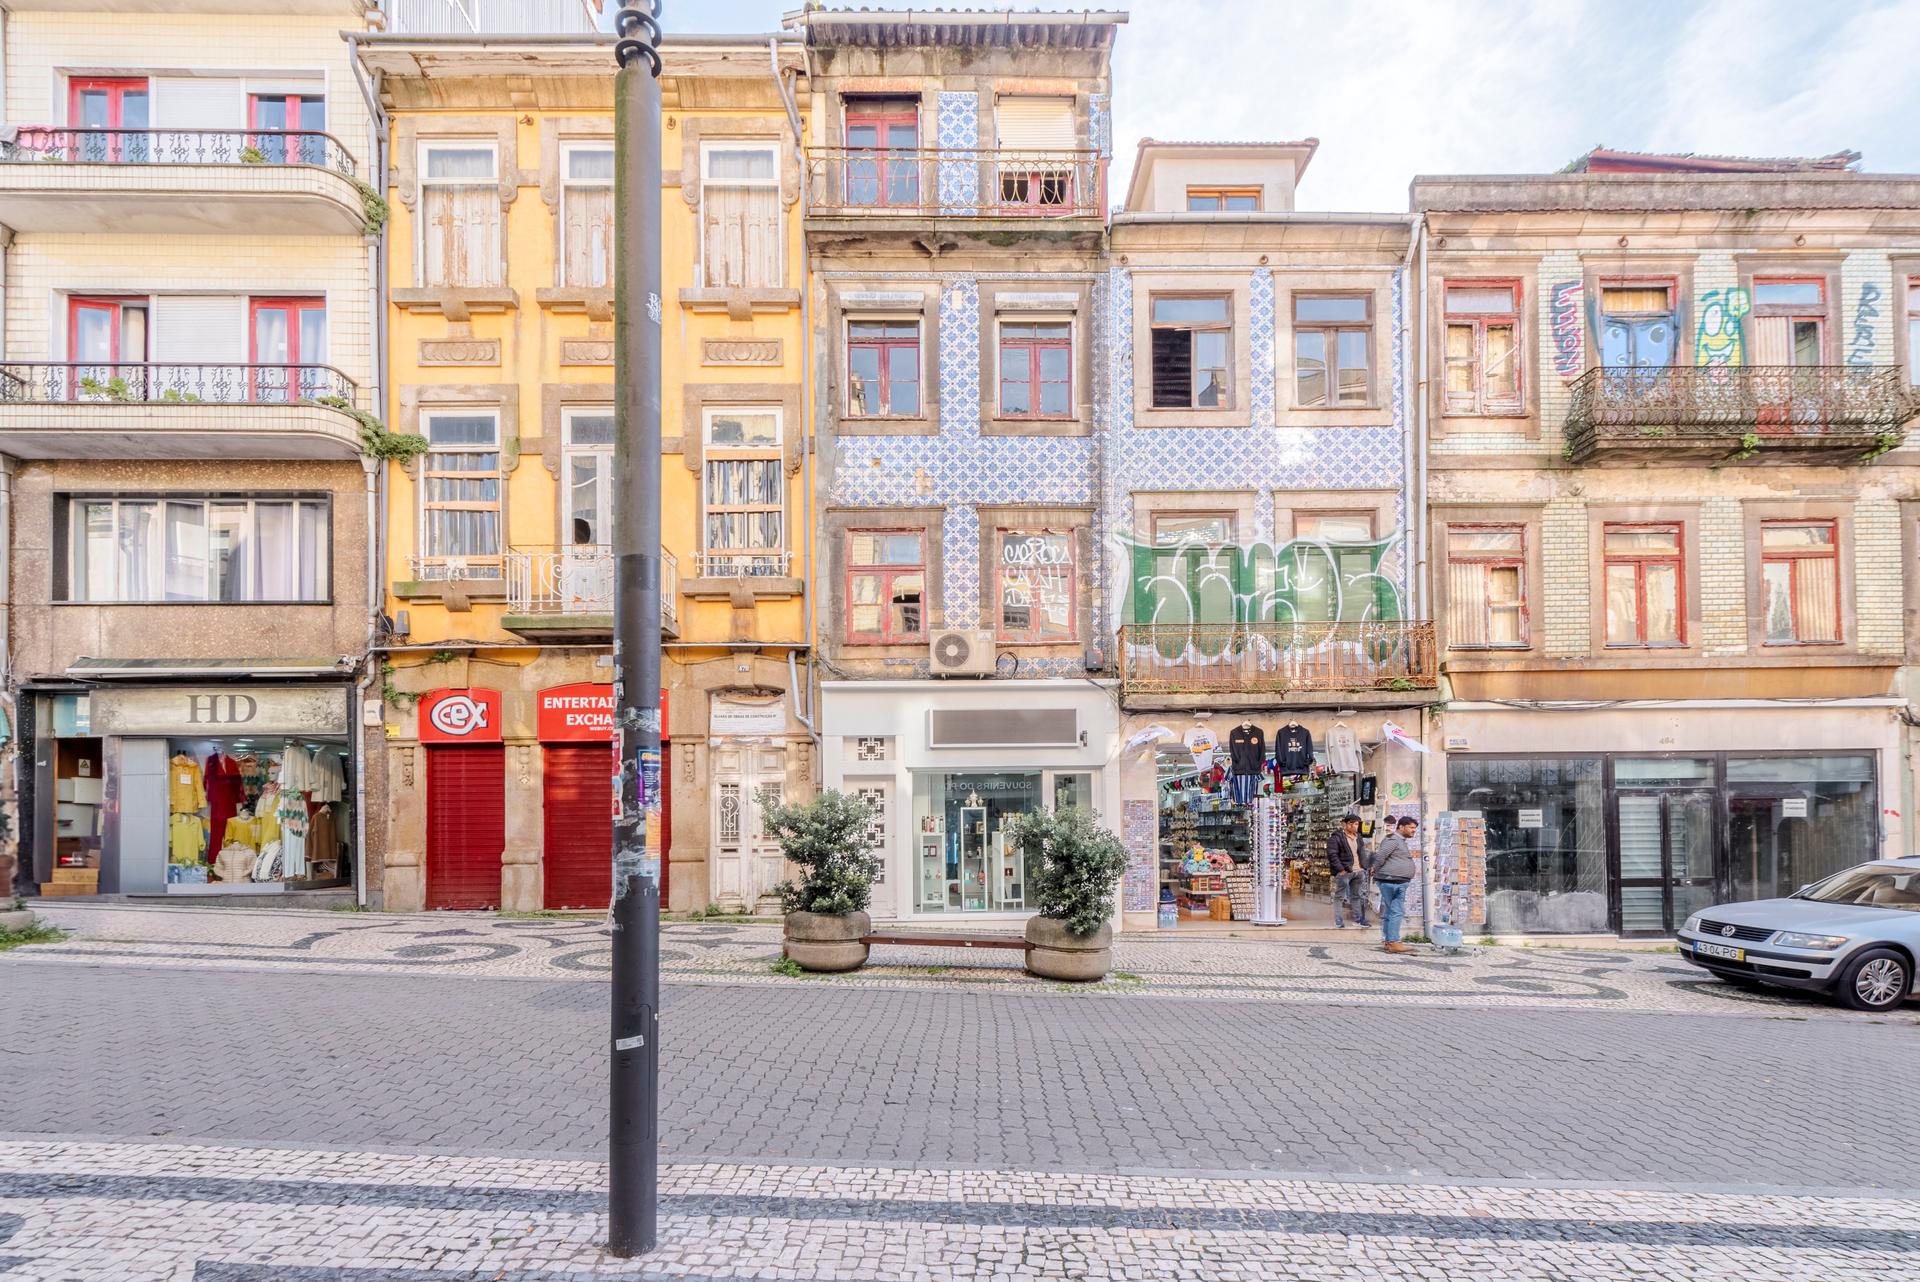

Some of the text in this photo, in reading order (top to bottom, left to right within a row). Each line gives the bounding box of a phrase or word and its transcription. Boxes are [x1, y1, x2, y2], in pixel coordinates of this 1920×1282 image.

[185, 694, 258, 724] HD
[543, 696, 615, 709] ENTERTAI
[566, 713, 615, 726] EXCHA
